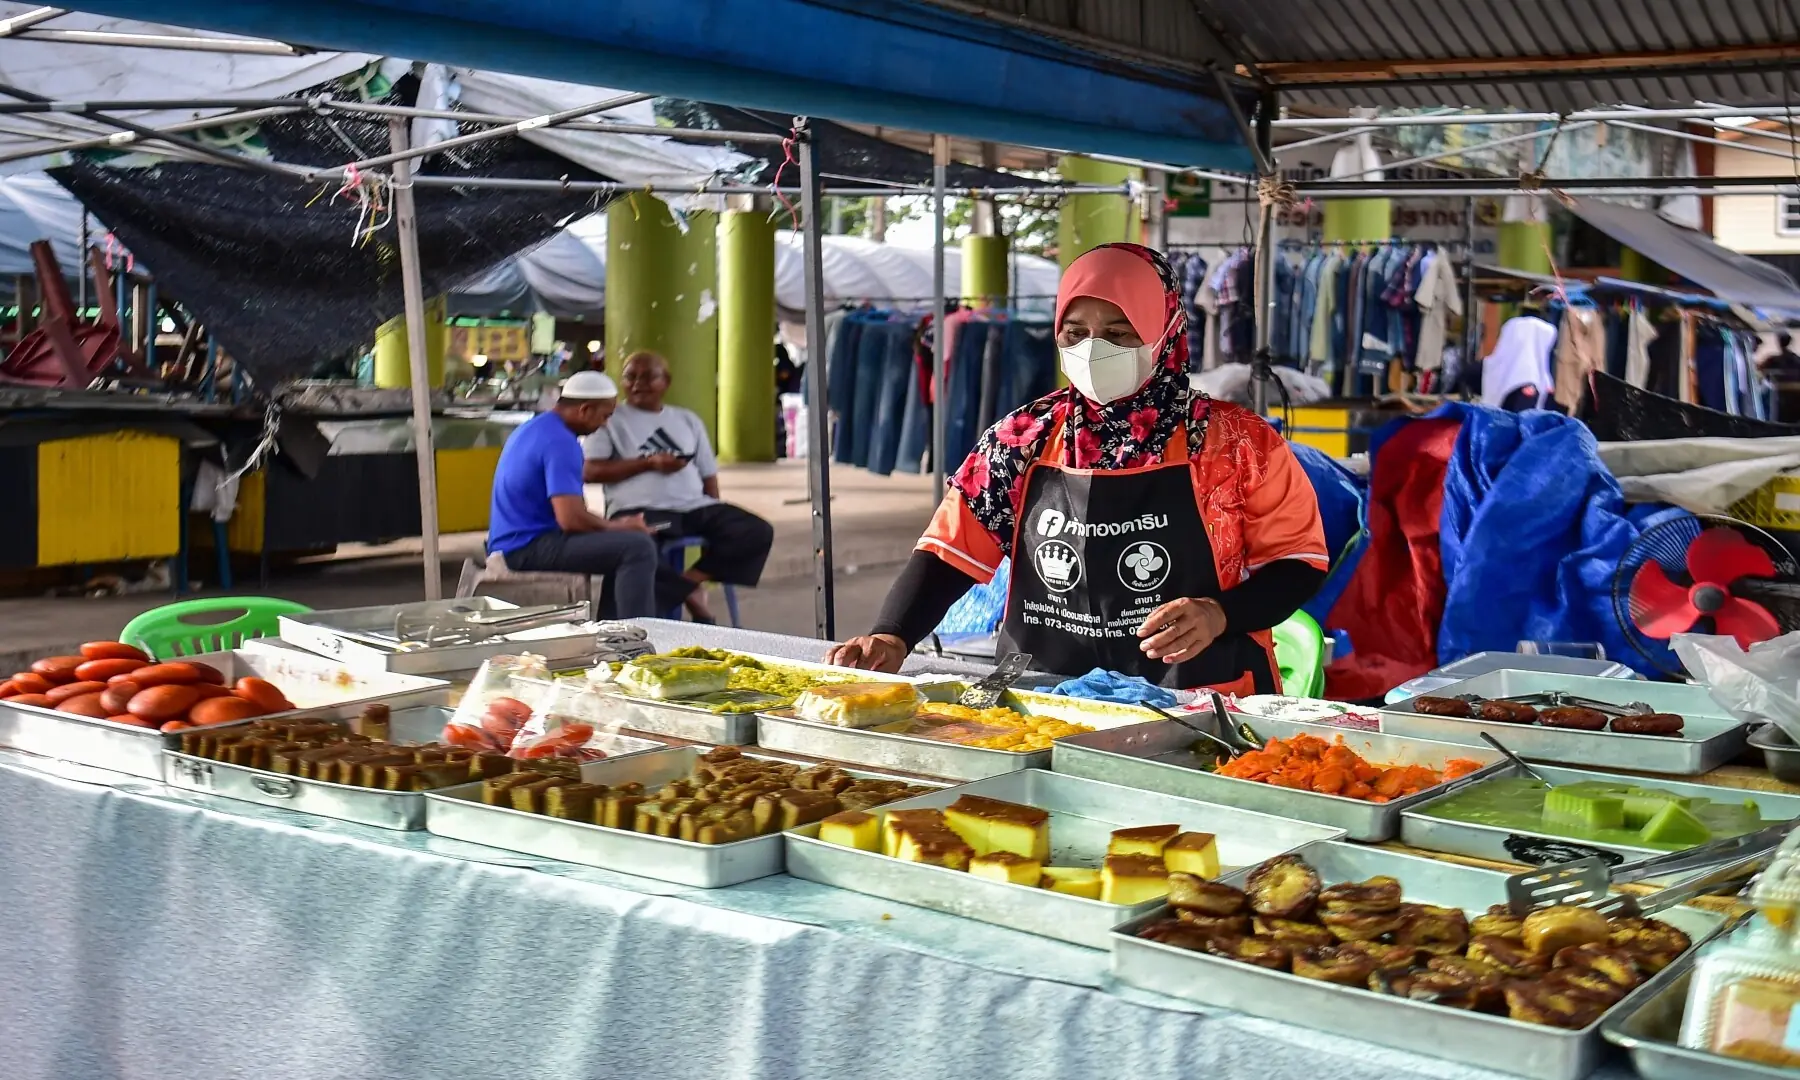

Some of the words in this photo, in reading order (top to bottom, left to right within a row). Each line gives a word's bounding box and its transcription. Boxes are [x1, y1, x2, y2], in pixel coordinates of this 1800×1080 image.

[1134, 596, 1153, 605] สาขา
[1155, 593, 1161, 602] 2
[1044, 617, 1103, 638] 073-530735
